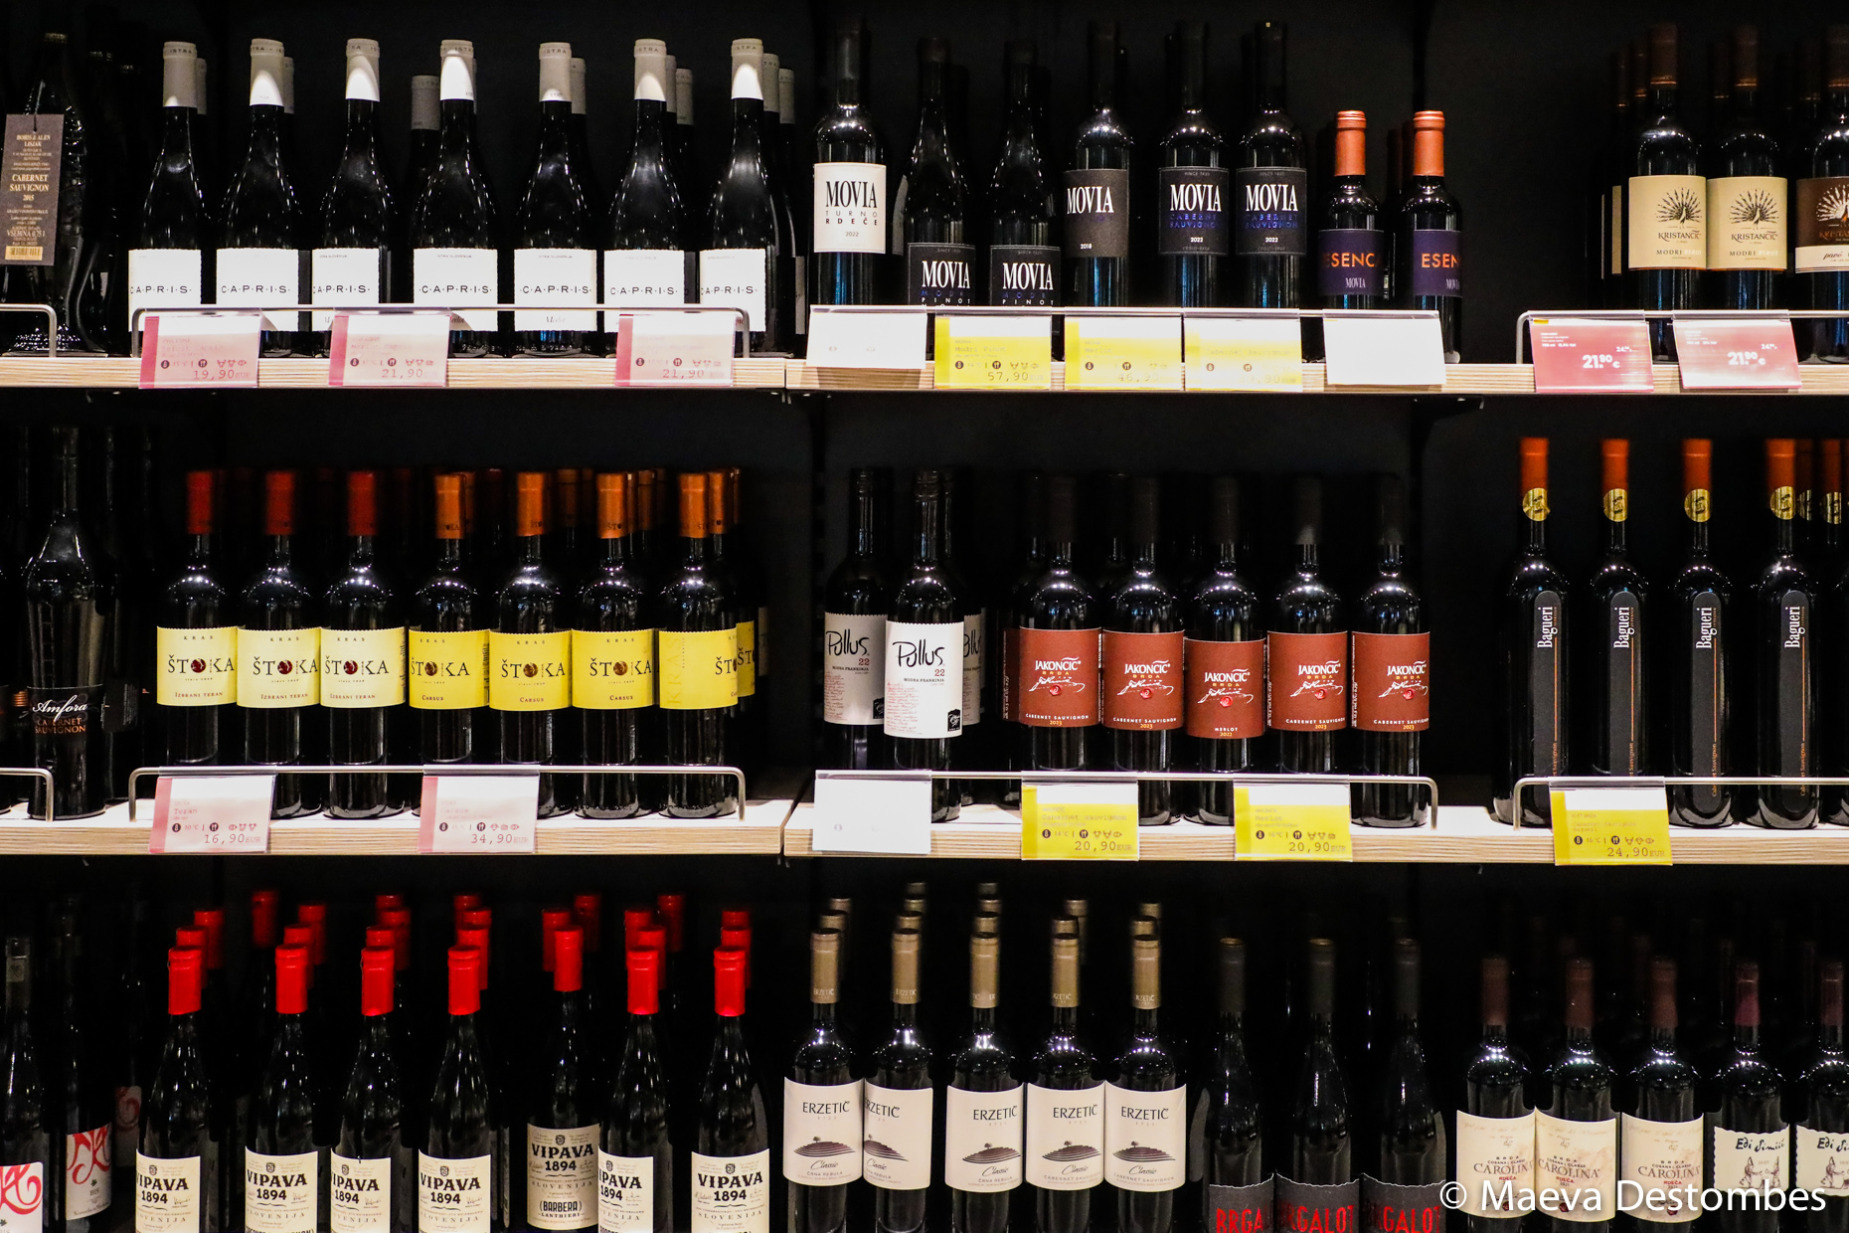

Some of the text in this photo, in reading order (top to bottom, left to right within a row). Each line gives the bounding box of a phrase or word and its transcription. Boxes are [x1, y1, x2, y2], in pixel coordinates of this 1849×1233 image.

[12, 174, 48, 182] CABERNET
[10, 184, 50, 192] SAUVIGNON
[826, 180, 877, 208] MOVIA
[1066, 186, 1114, 214] MOVIA
[1170, 183, 1221, 212] MOVIA
[1245, 183, 1298, 212] MOVIA
[922, 260, 970, 289] MOVIA
[1002, 262, 1053, 290] MOVIA
[1345, 277, 1366, 289] MOVIA
[193, 370, 235, 380] 19,90
[381, 369, 423, 379] 21,90
[662, 369, 705, 380] 21,90
[987, 371, 1029, 382] 57,90
[1537, 605, 1558, 649] Bagueri
[1613, 606, 1635, 649] Bagueri
[1696, 606, 1718, 650] Bagueri
[1784, 605, 1806, 649] Bagueri
[892, 638, 946, 668] Pullus
[858, 658, 870, 666] 22
[934, 668, 946, 677] 22
[32, 694, 88, 722] Amfora
[37, 717, 82, 726] CAERNET
[204, 833, 245, 844] 16,90
[471, 833, 513, 845] 34,90
[1074, 840, 1117, 852] 20,90
[1288, 842, 1330, 853] 20,90
[1607, 847, 1649, 858] 24,90
[1735, 1136, 1753, 1150] Edi
[1816, 1136, 1834, 1150] Edi
[531, 1142, 594, 1159] VIPAVA
[545, 1160, 577, 1172] 1894
[247, 1168, 307, 1187] VIPAVA
[420, 1172, 481, 1192] VIPAVA
[599, 1168, 642, 1189] IPAVA
[697, 1171, 763, 1189] VIPAVA
[141, 1190, 168, 1204] 1894
[256, 1188, 287, 1201] 1894
[335, 1189, 360, 1204] 1894
[430, 1191, 461, 1204] 1894
[600, 1185, 623, 1201] 1894
[713, 1189, 747, 1202] 1894
